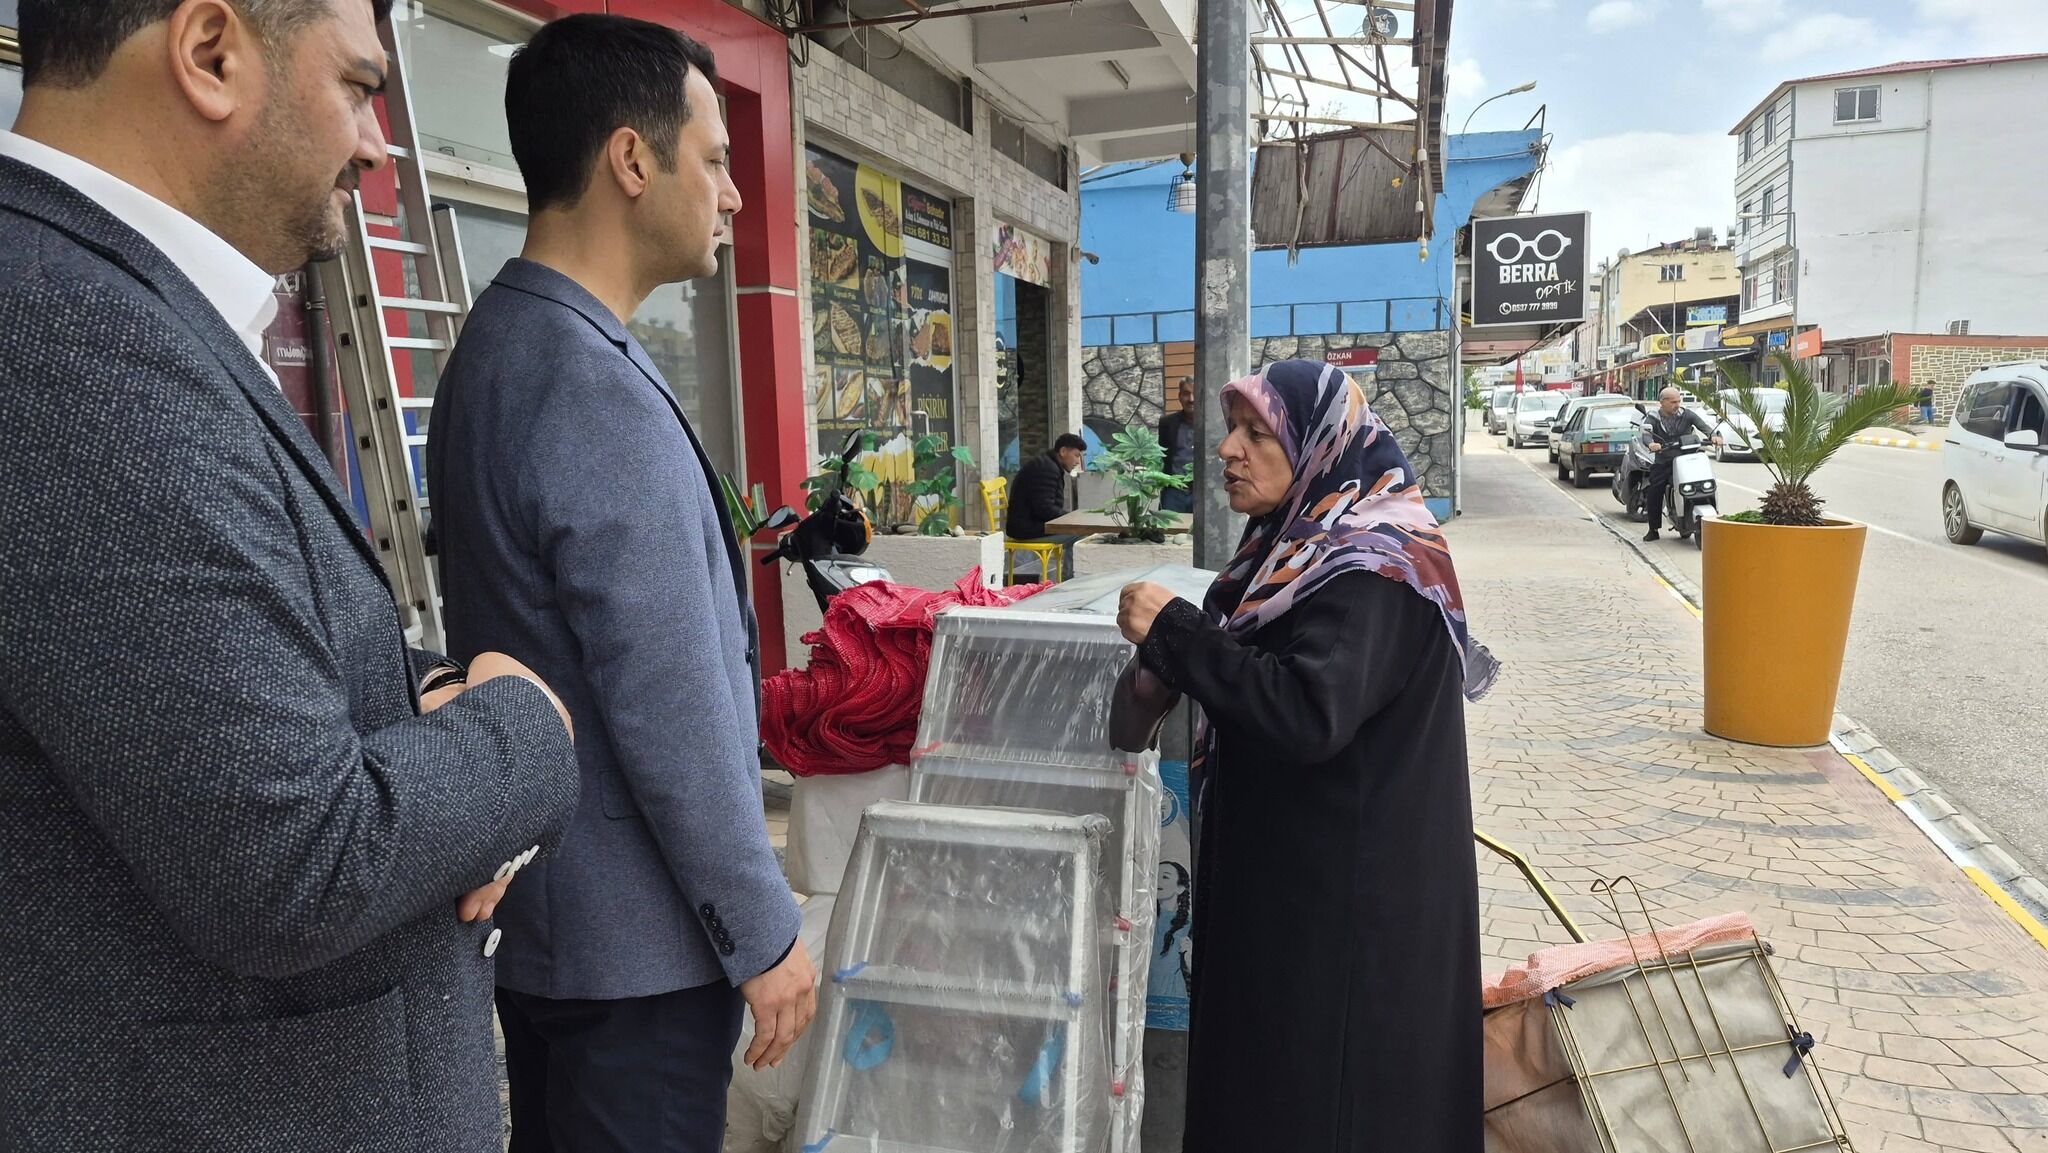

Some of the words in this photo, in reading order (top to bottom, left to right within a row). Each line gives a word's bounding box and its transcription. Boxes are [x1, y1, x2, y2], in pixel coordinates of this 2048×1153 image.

[931, 232, 940, 244] 33
[941, 235, 950, 247] 33
[1499, 262, 1559, 284] BERRA
[1512, 304, 1527, 312] 0537
[1529, 303, 1540, 311] 777
[1326, 350, 1352, 360] ÖZKAN
